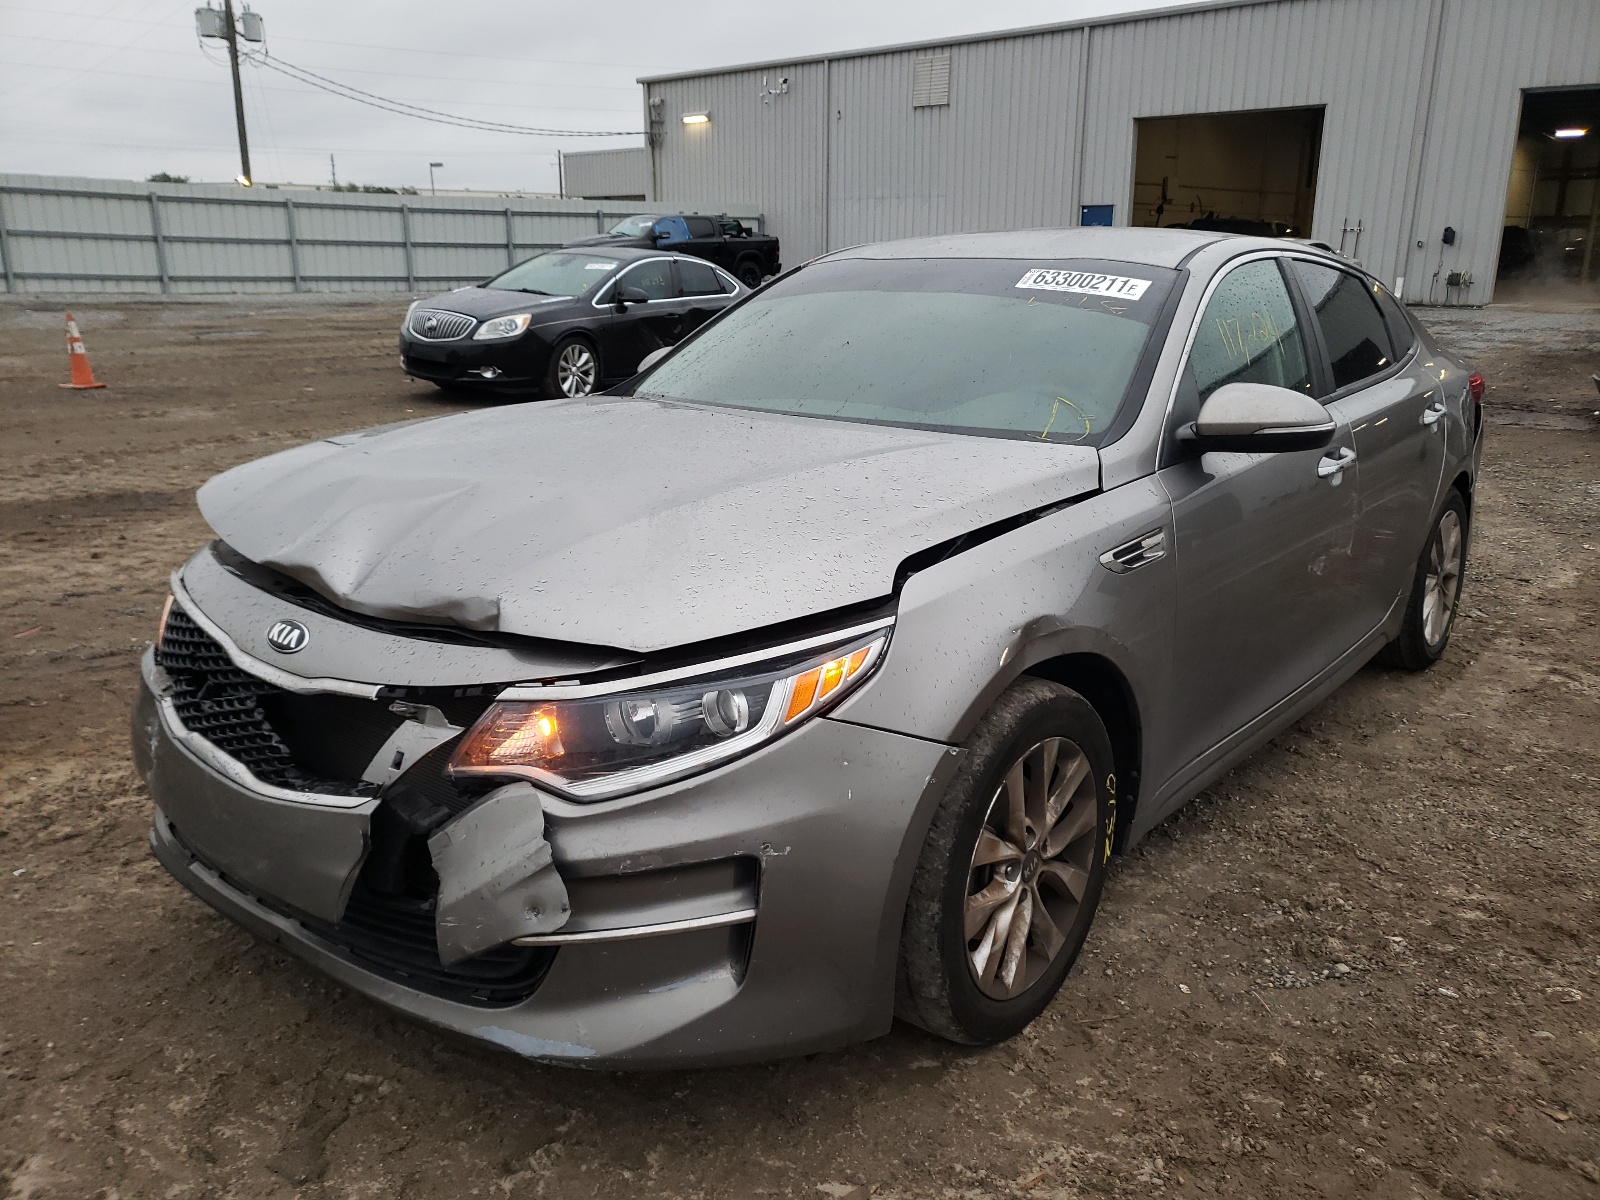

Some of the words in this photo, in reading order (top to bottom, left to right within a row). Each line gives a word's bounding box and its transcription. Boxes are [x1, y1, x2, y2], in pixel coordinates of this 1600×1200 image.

[1033, 271, 1130, 292] 63300211
[269, 622, 300, 648] KIA
[1024, 856, 1038, 878] KIA
